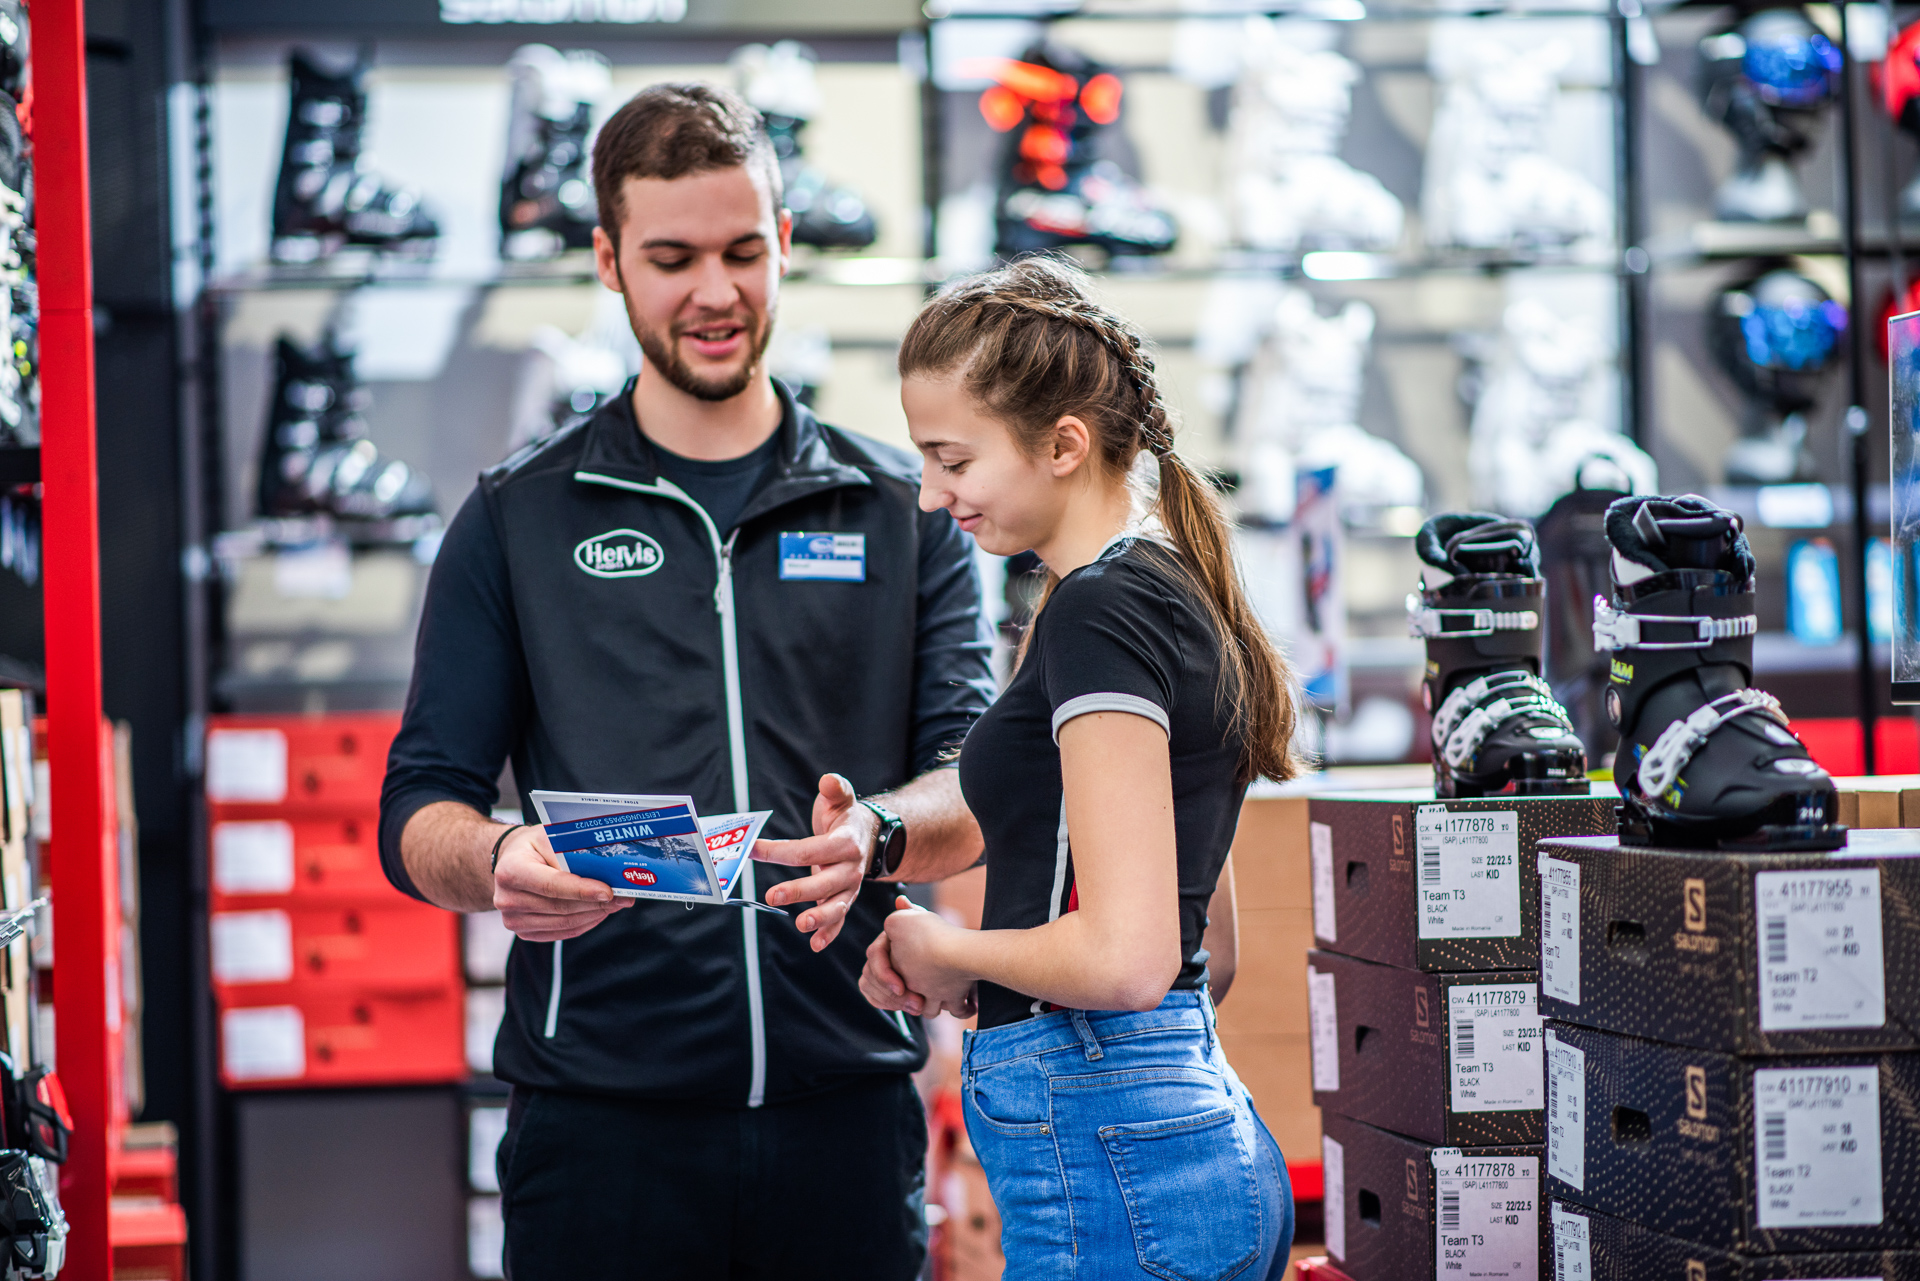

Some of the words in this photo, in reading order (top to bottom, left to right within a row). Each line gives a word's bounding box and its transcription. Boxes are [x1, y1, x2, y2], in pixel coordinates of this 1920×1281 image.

[585, 541, 657, 568] Hervis
[603, 811, 661, 824] LEISTUNGSPASS
[575, 818, 603, 829] 2021/22
[1435, 818, 1494, 832] 41177878
[594, 824, 654, 842] WINTER
[732, 829, 744, 842] €
[1442, 836, 1458, 845] (SAP)
[1460, 836, 1488, 844] L41177800
[1487, 855, 1512, 866] 22/22.5
[624, 871, 656, 884] Hervis
[1486, 869, 1499, 879] KID
[1781, 879, 1852, 898] 41177955
[1423, 890, 1450, 901] Team
[1453, 890, 1466, 900] T3
[1427, 904, 1448, 913] BLACK
[1428, 916, 1444, 924] White
[1544, 943, 1554, 956] Team
[1842, 943, 1860, 956] KID
[1768, 969, 1800, 983] Team
[1803, 968, 1818, 983] T2
[1467, 990, 1526, 1005] 41177879
[1475, 1009, 1489, 1018] (SAP)
[1491, 1008, 1519, 1017] L41177800
[1518, 1028, 1543, 1038] 23/23.5
[1518, 1042, 1530, 1052] KID
[1456, 1064, 1480, 1073] Team
[1482, 1062, 1494, 1072] T3
[1460, 1078, 1480, 1086] BLACK
[1778, 1076, 1850, 1094] 41177910
[1460, 1090, 1476, 1098] White
[1840, 1139, 1857, 1153] KID
[1455, 1163, 1515, 1177] 41177878
[1765, 1165, 1795, 1178] Team
[1798, 1164, 1811, 1178] T2
[1462, 1181, 1477, 1190] (SAP)
[1479, 1181, 1508, 1189] L41177800
[1506, 1201, 1531, 1211] 22/22.5
[1505, 1215, 1518, 1225] KID
[1441, 1235, 1468, 1246] Team
[1471, 1235, 1484, 1245] T3
[1445, 1250, 1466, 1258] BLACK
[1446, 1262, 1462, 1270] White
